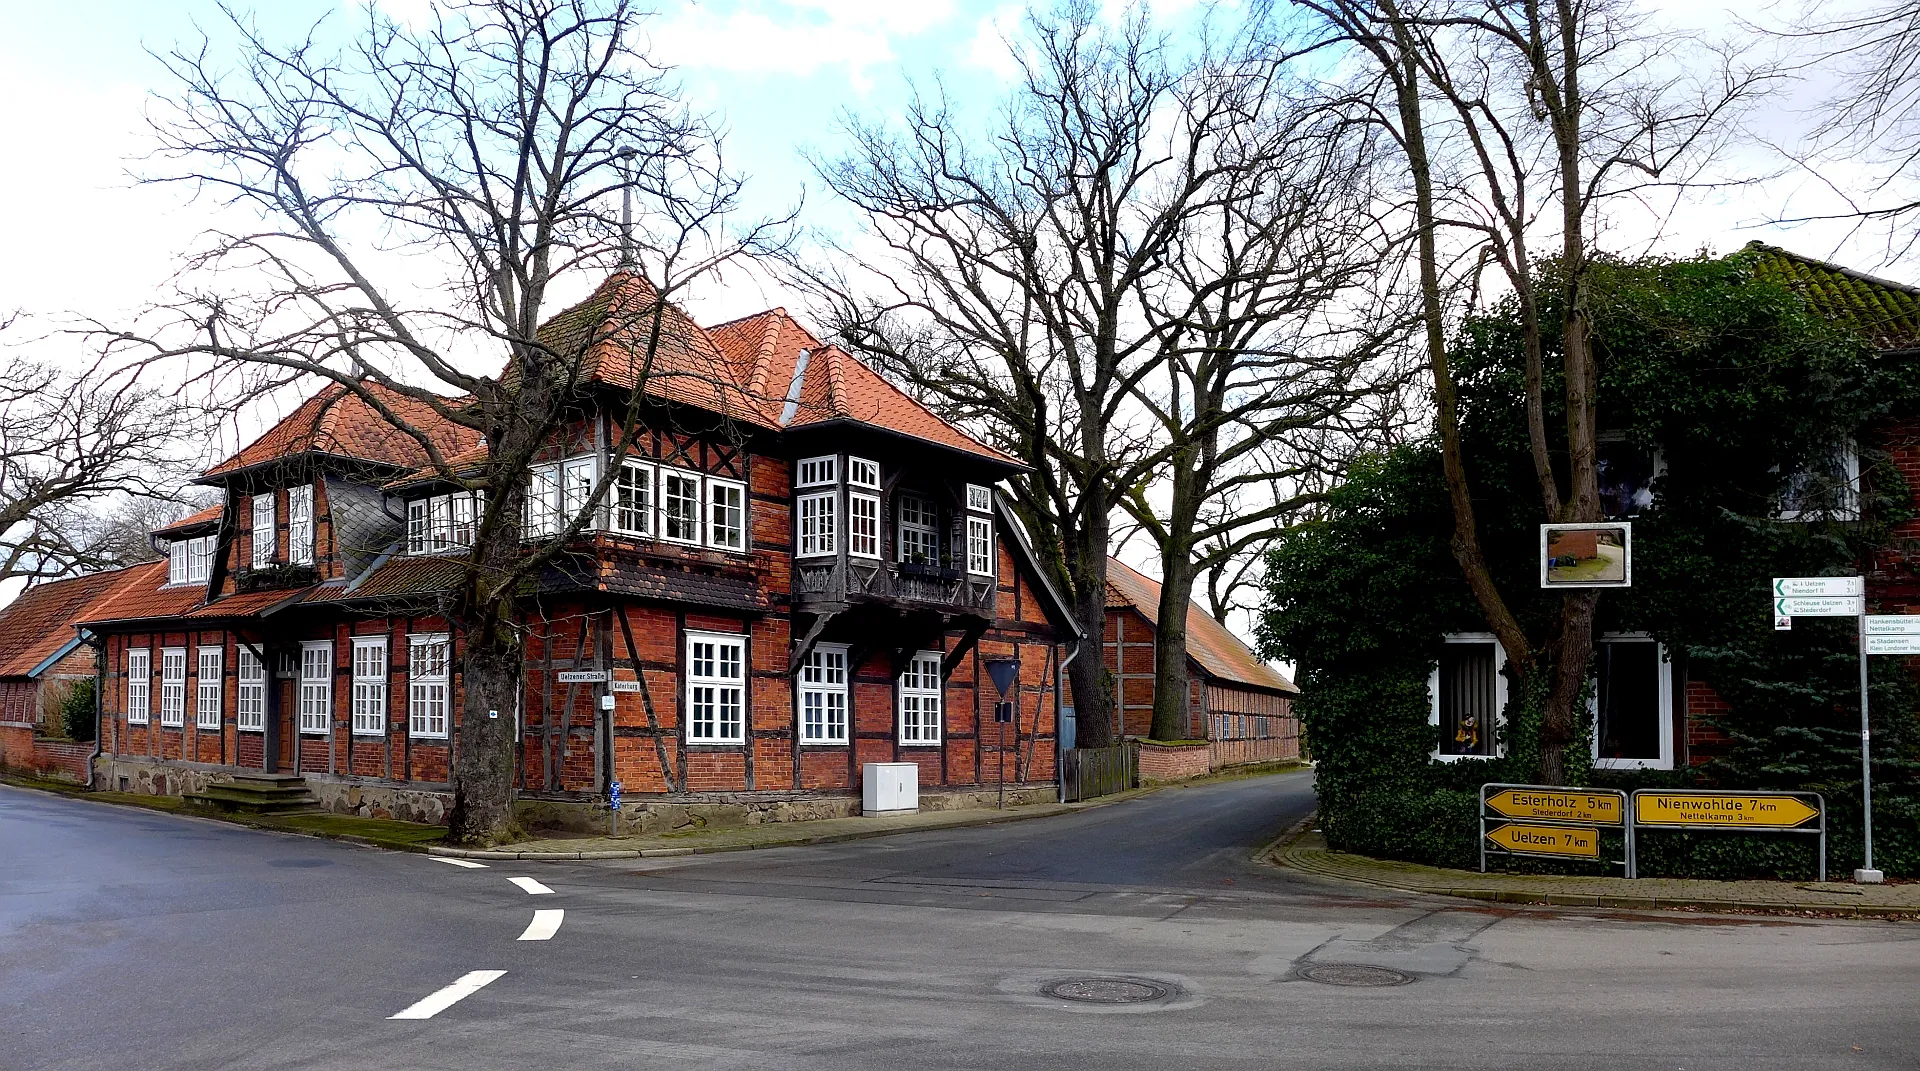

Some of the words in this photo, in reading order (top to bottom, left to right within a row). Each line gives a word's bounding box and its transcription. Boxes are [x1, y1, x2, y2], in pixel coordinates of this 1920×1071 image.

[587, 672, 605, 680] Straße
[614, 682, 638, 690] Katerburg
[1512, 793, 1577, 808] Esterholz
[1587, 797, 1596, 809] 5
[1598, 799, 1612, 810] km
[1657, 797, 1743, 811] Nienwohlde
[1750, 799, 1758, 811] 7
[1759, 801, 1777, 811] km
[1532, 809, 1573, 818] Stederdorf
[1680, 812, 1734, 821] Nettelkamp
[1737, 813, 1743, 821] 3
[1511, 831, 1556, 846] Uelzen
[1564, 834, 1573, 846] 7
[1574, 837, 1588, 848] km
